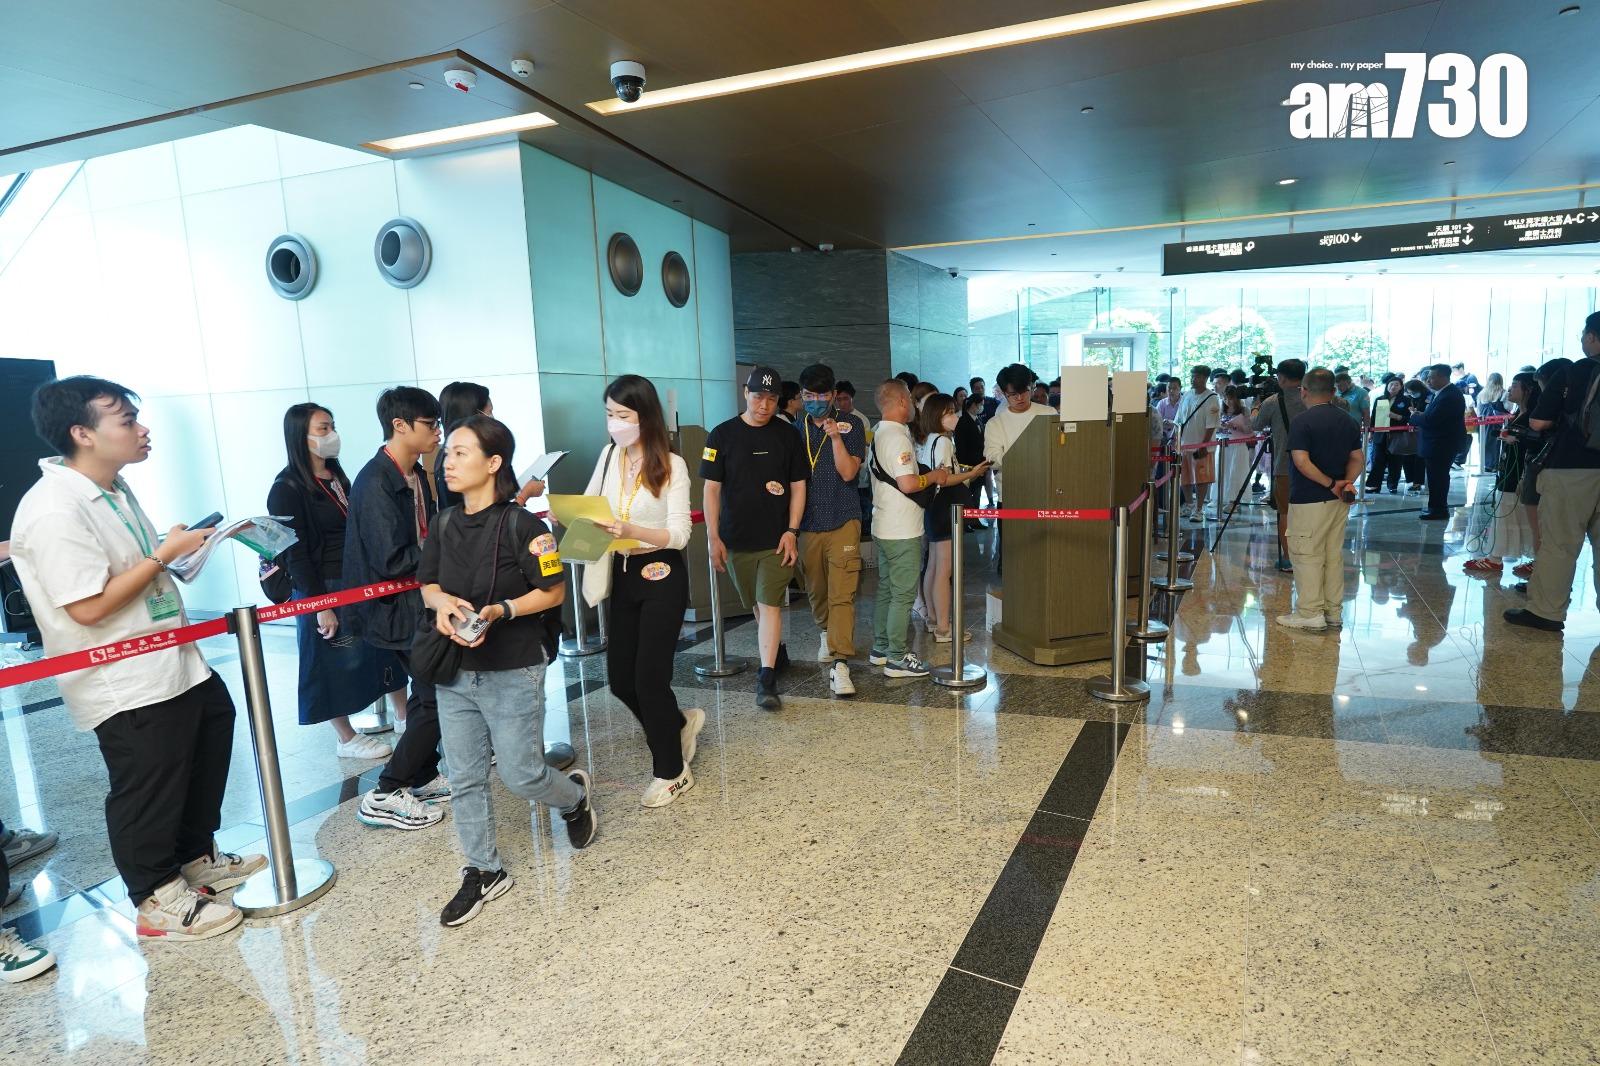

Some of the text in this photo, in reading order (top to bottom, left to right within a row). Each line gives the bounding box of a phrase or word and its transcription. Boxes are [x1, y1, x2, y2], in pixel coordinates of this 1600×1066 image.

[1563, 213, 1585, 225] A-C
[1319, 233, 1350, 246] sky100
[762, 374, 772, 386] NY
[279, 604, 294, 615] Kai
[296, 596, 338, 611] Properties
[121, 649, 138, 657] Hung
[149, 639, 177, 649] Properties
